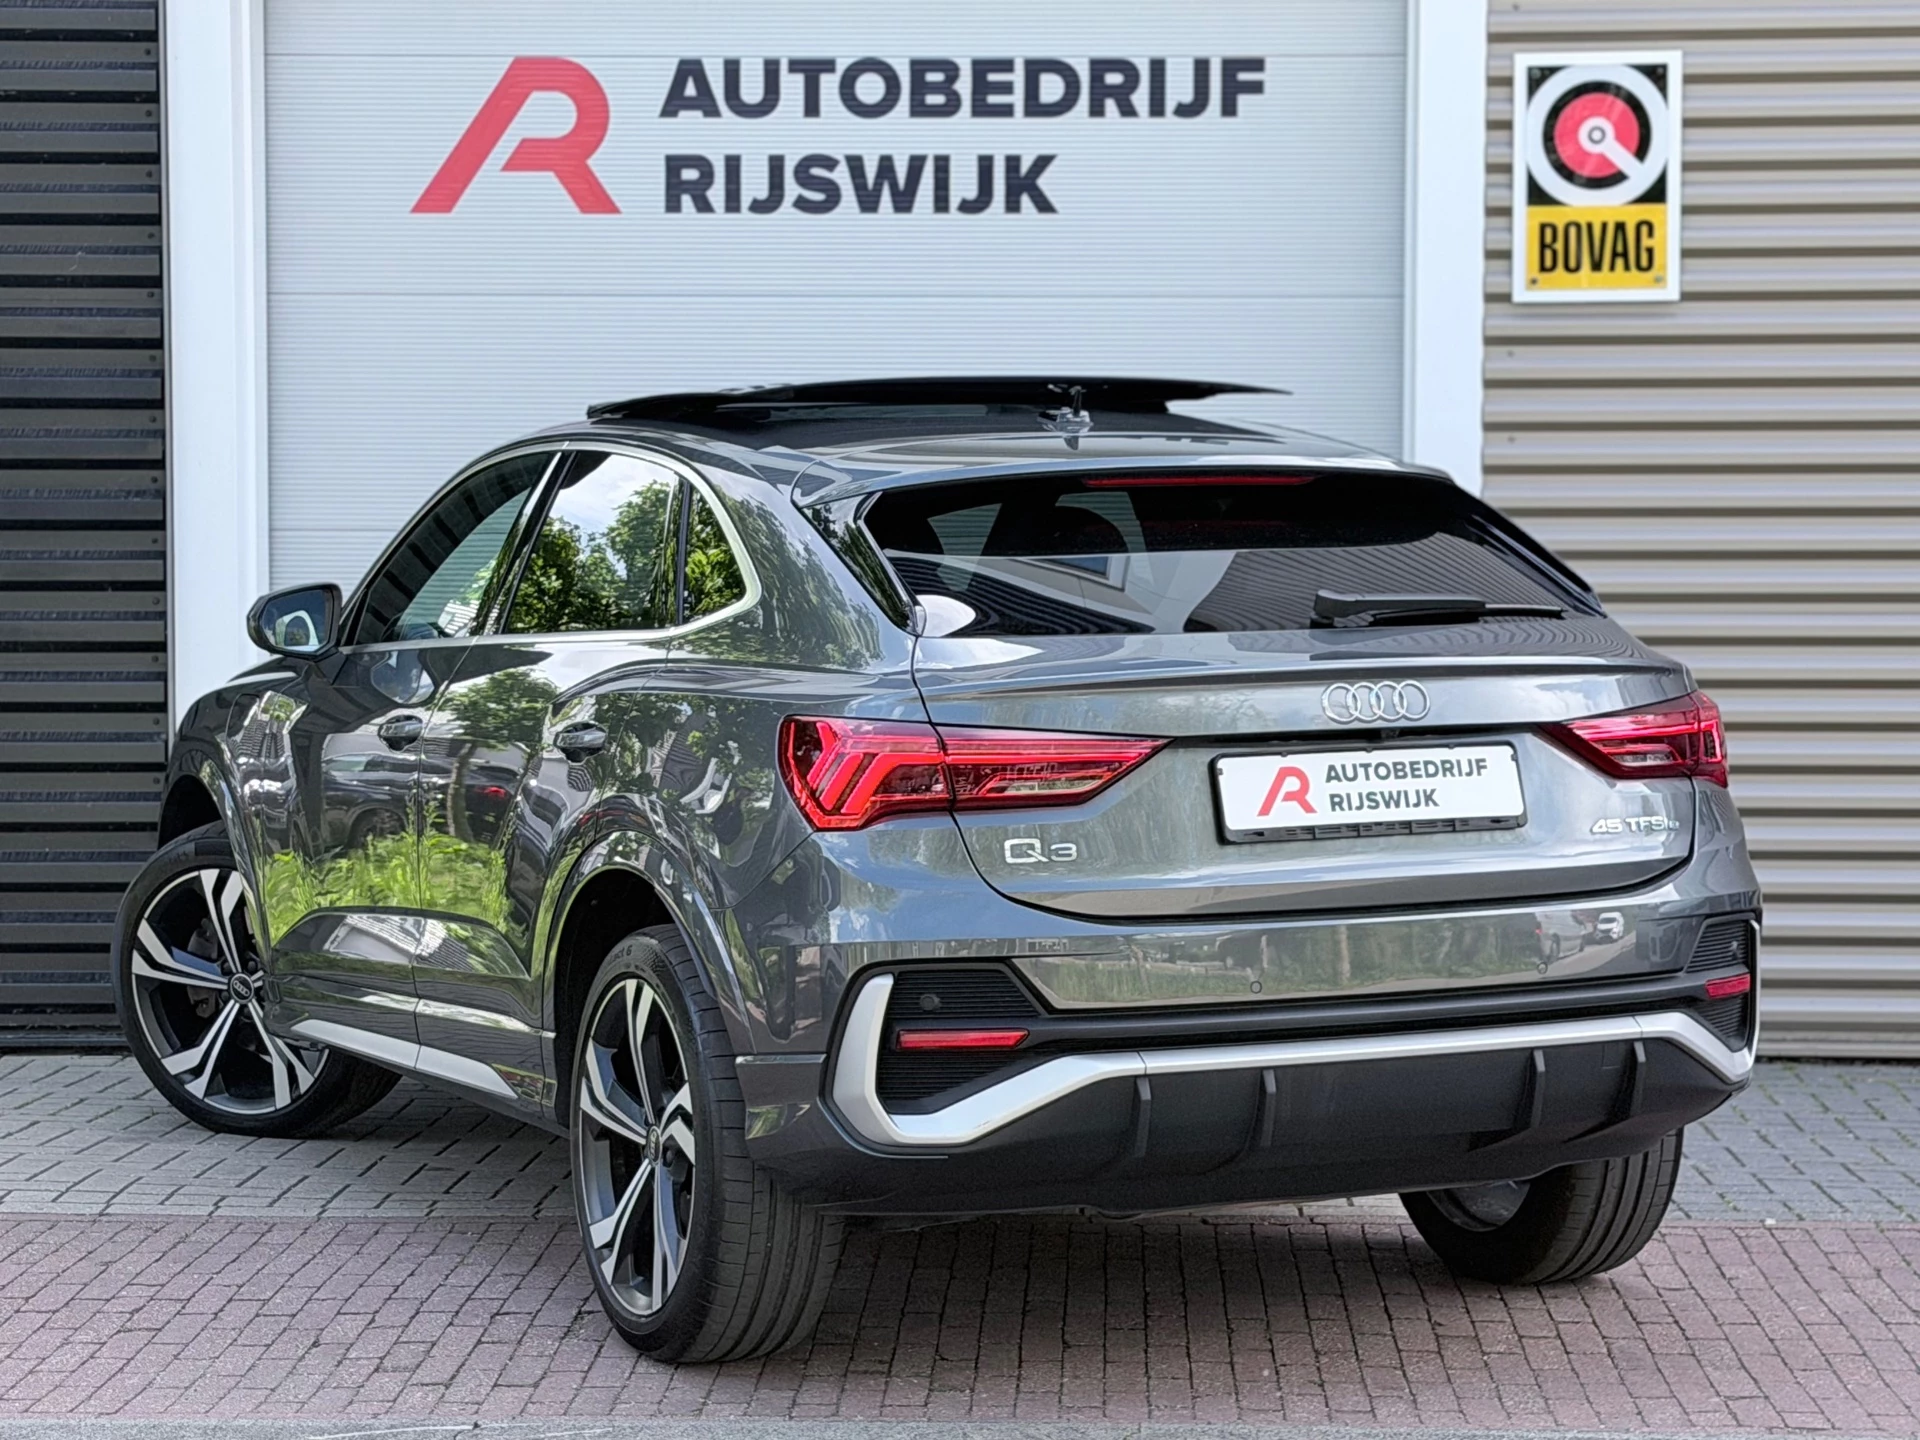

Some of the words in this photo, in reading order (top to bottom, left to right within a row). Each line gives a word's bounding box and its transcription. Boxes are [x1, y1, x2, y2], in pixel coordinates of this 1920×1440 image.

[659, 57, 1266, 119] AUTOBEDRIJF
[664, 154, 1058, 214] RIJSWIJK
[1538, 220, 1655, 275] BOVAG
[1325, 758, 1488, 784] AUTOBEDRIJF
[1328, 788, 1440, 812] RIJSWIJK
[1591, 818, 1623, 833] 45
[1003, 838, 1078, 864] Q3
